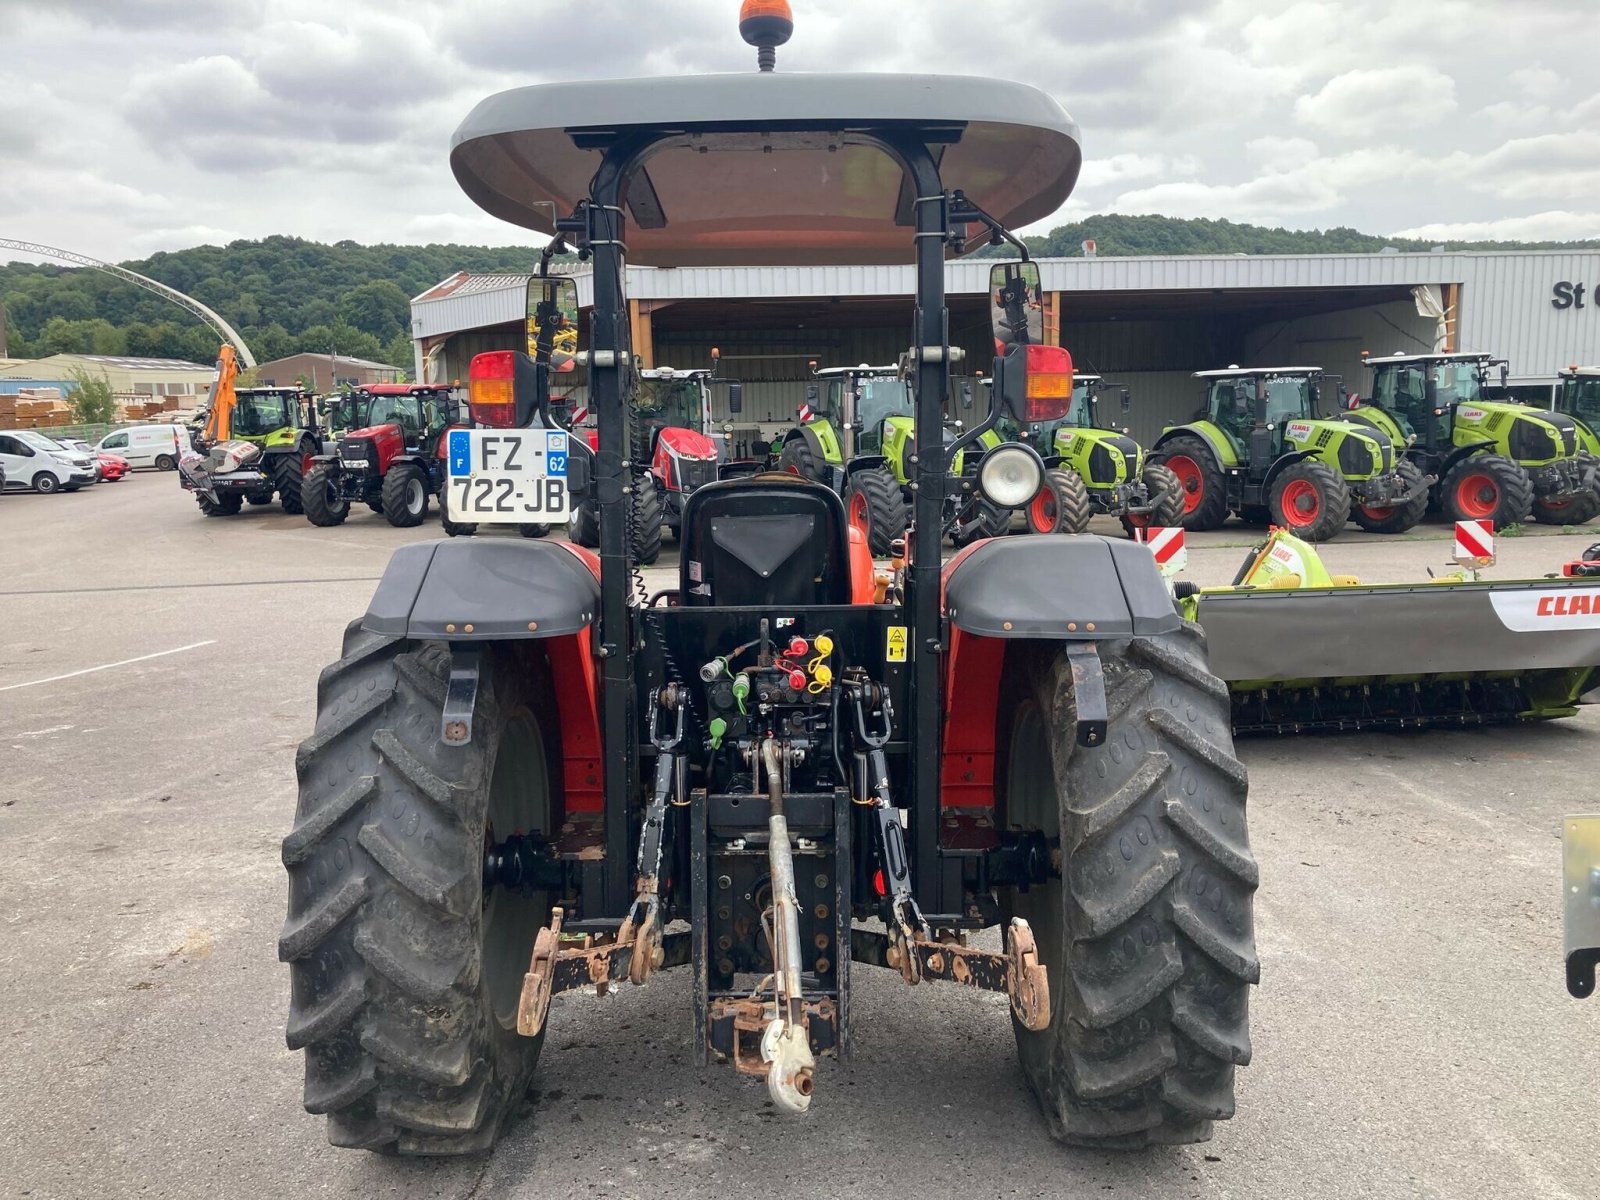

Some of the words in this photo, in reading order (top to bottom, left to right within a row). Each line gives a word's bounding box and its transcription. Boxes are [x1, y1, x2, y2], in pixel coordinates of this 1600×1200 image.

[1552, 281, 1585, 309] St
[1291, 424, 1310, 432] CLAAS
[456, 458, 464, 468] F
[550, 456, 565, 471] 62
[453, 478, 564, 512] 722-JB
